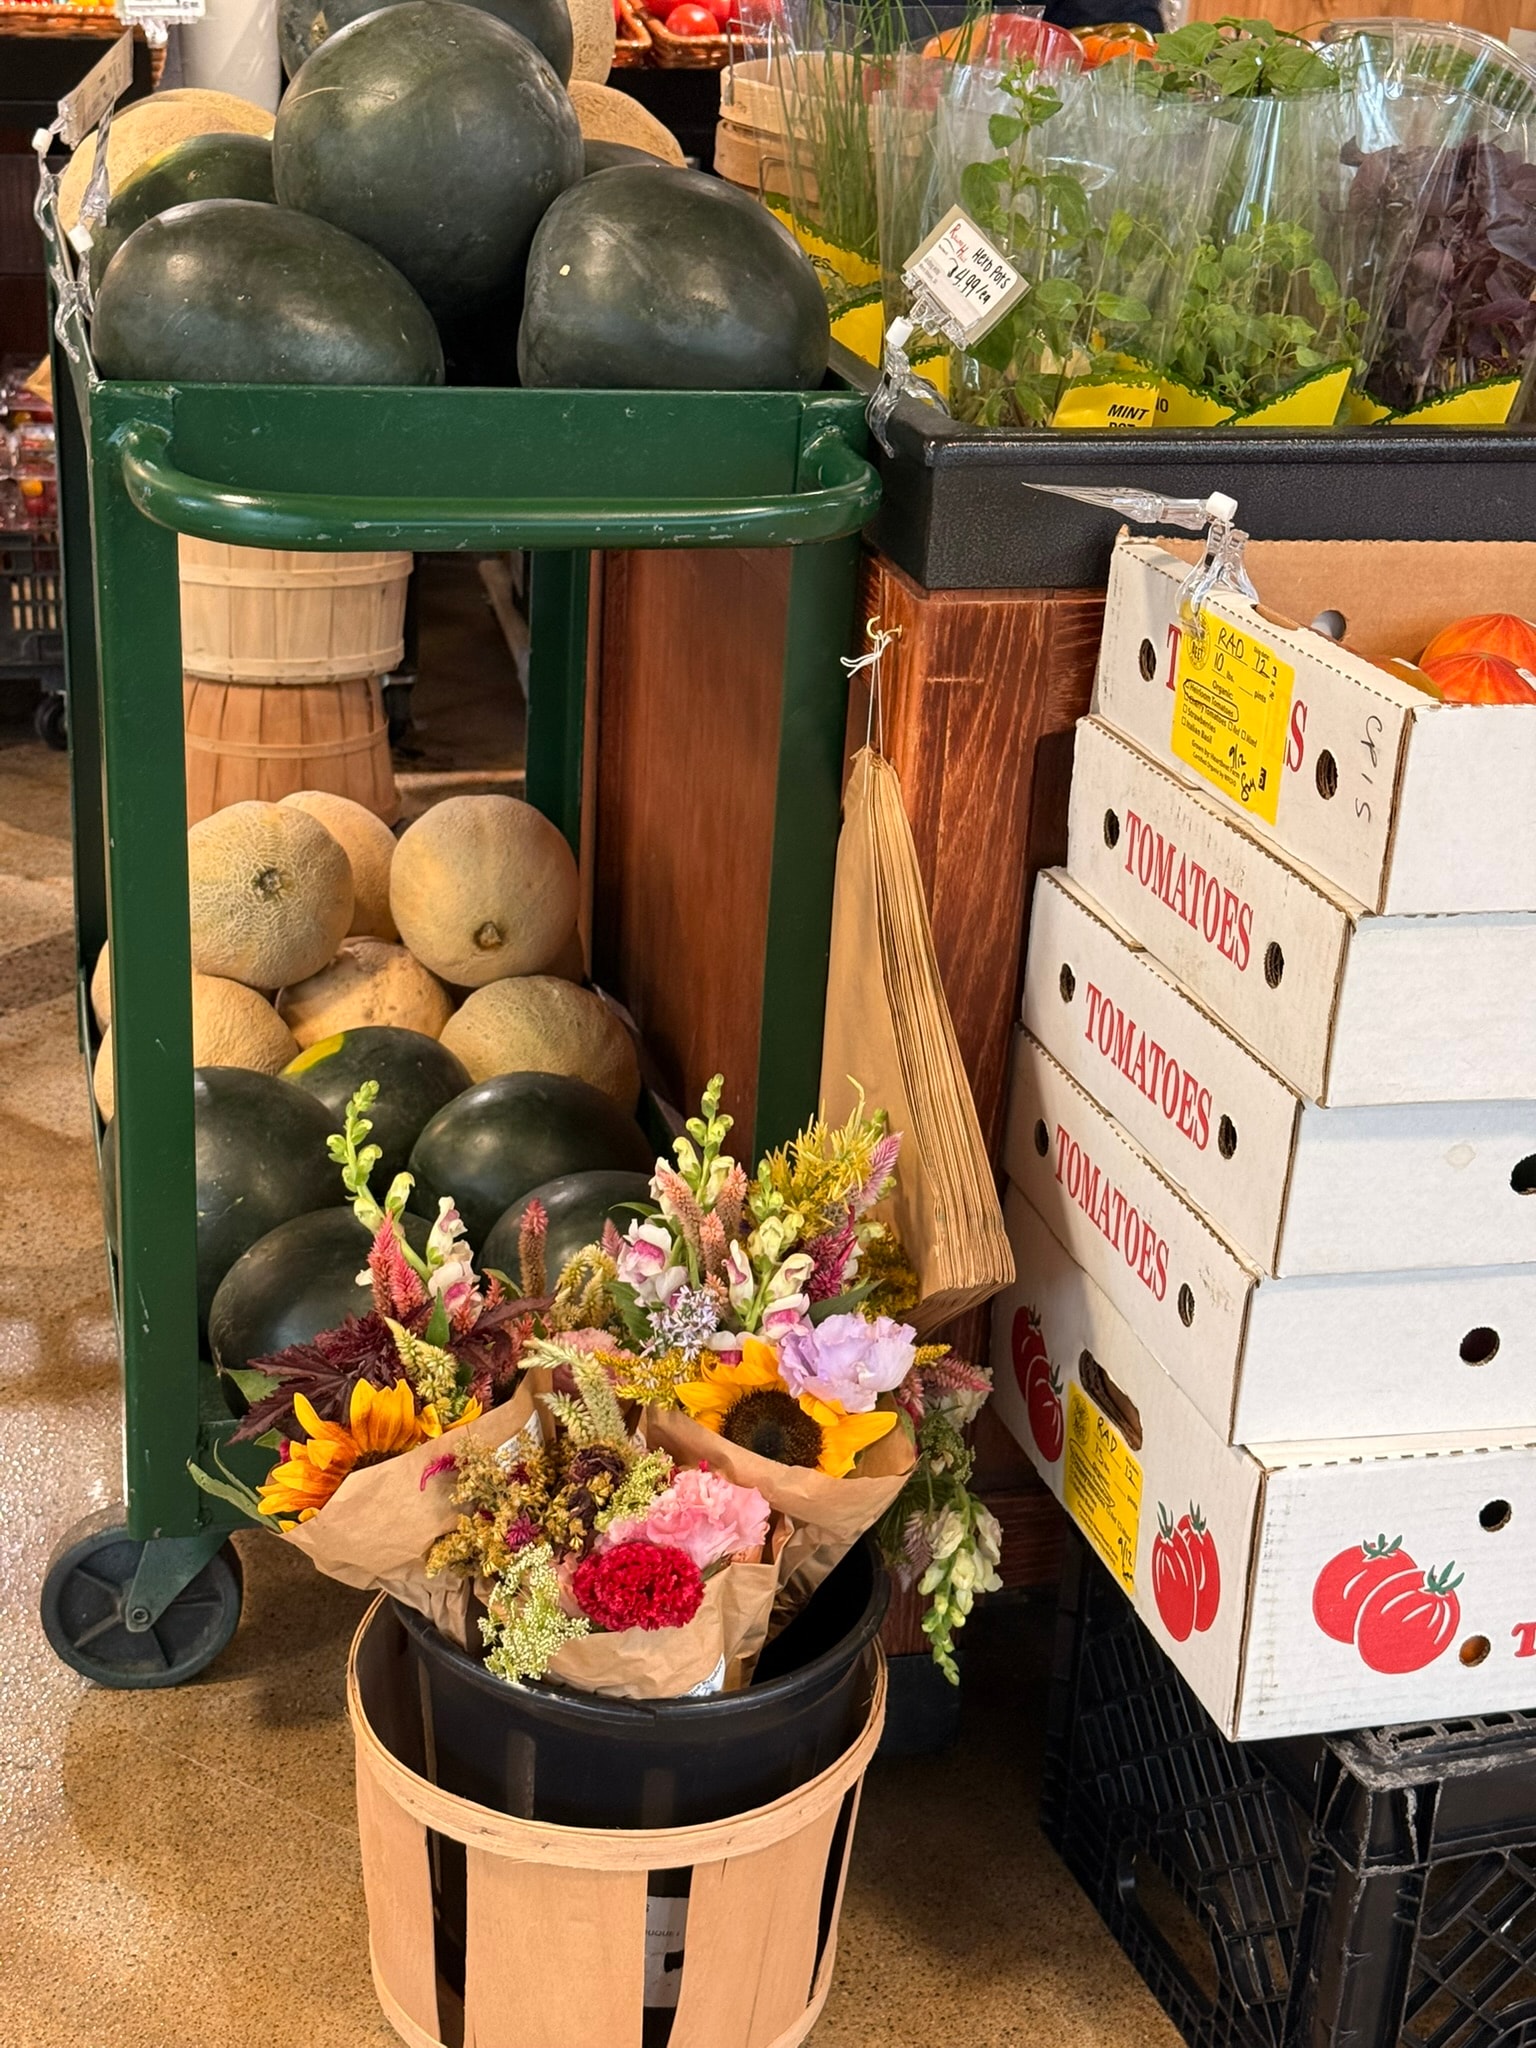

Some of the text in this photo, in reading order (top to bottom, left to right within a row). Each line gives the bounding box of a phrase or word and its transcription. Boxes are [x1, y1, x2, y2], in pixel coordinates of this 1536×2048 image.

[971, 247, 993, 273] Herb
[989, 265, 1012, 289] Pots
[1107, 404, 1150, 421] MINT
[1218, 627, 1244, 659] RAD
[1214, 652, 1225, 672] 10
[1187, 707, 1217, 733] Strawberries
[1210, 696, 1234, 718] Tomatoes
[1125, 809, 1253, 972] TOMATOES
[1085, 981, 1213, 1151] TOMATOES
[1055, 1123, 1170, 1302] TOMATOES
